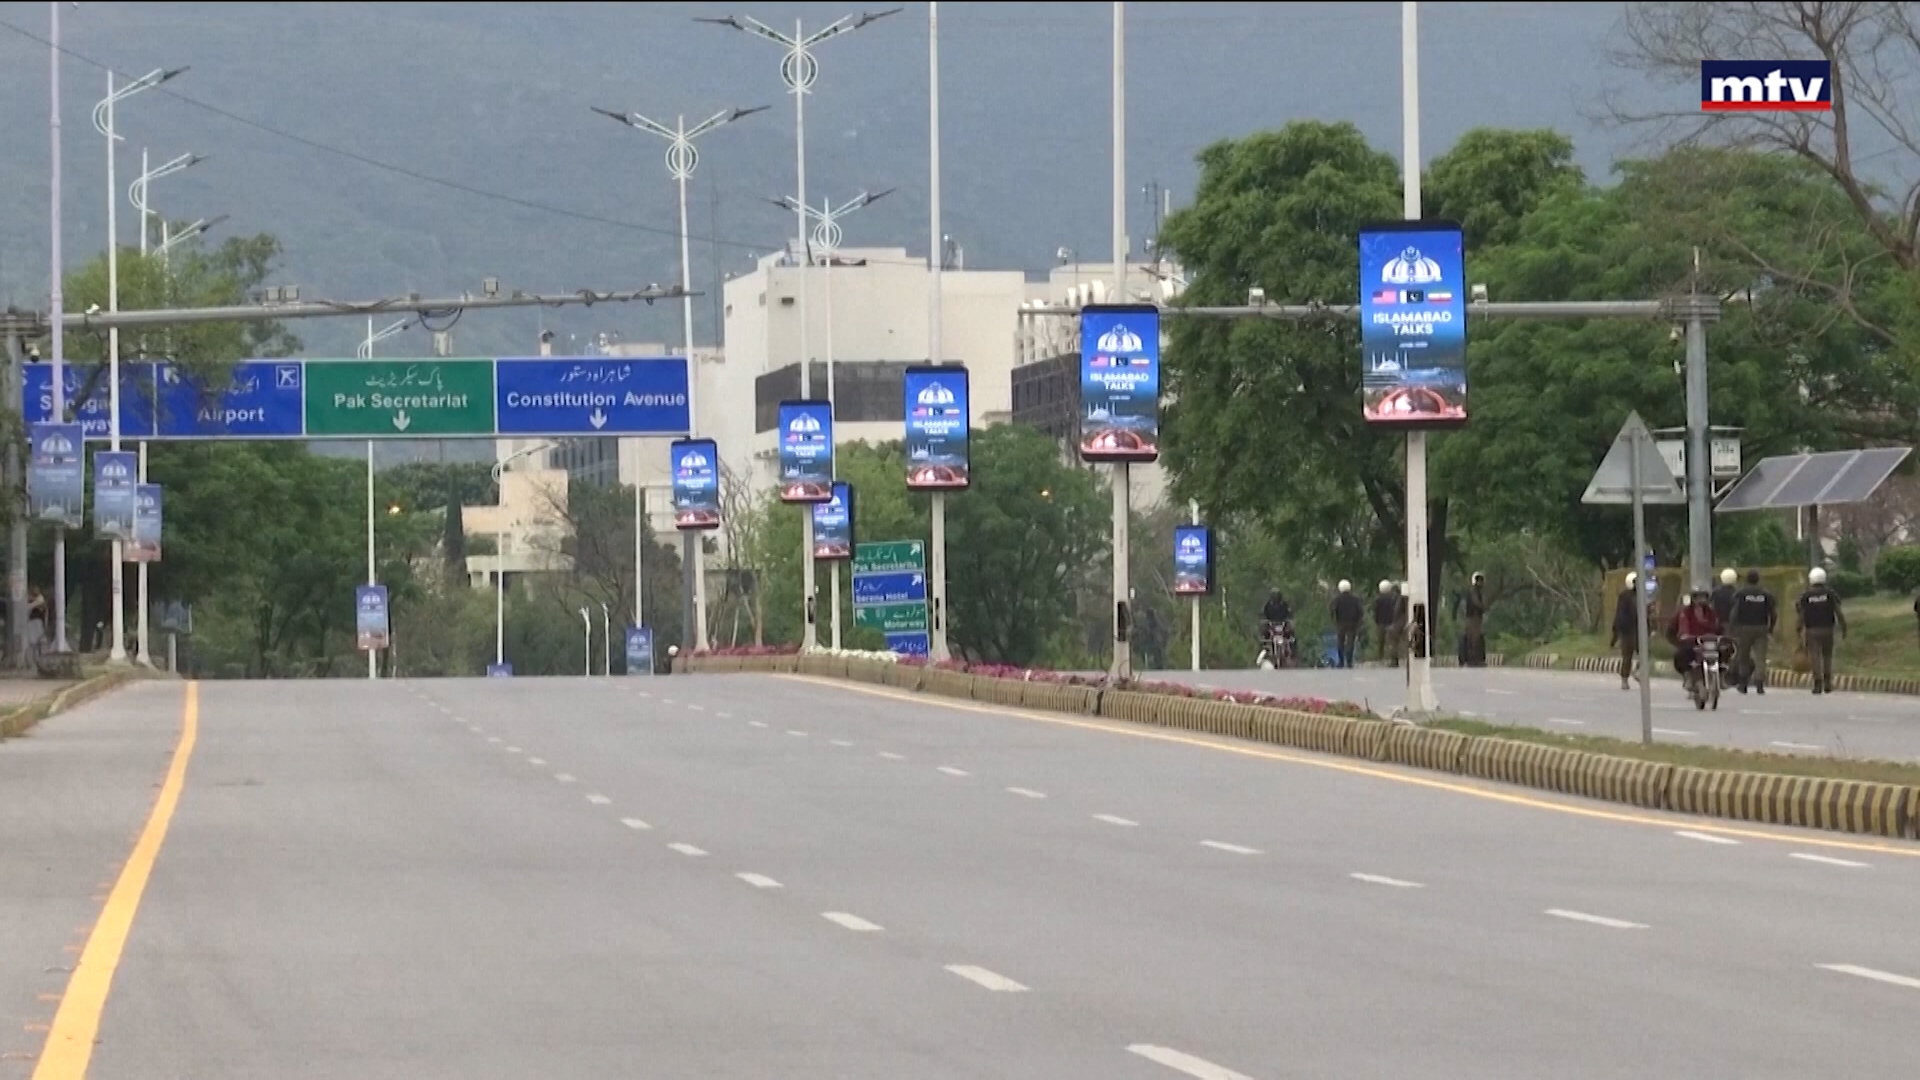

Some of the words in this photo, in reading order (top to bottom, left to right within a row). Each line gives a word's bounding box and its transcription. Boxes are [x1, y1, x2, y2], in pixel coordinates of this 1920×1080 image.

[1373, 310, 1452, 324] ISLAMABAD
[1392, 323, 1433, 336] TALKS
[1089, 372, 1149, 382] ISLAMABAD
[1104, 381, 1135, 391] TALKS
[334, 393, 366, 409] Pak
[371, 392, 469, 409] Secretariat
[506, 391, 617, 408] Constitution
[623, 391, 686, 407] Avenue
[198, 407, 265, 426] Airport
